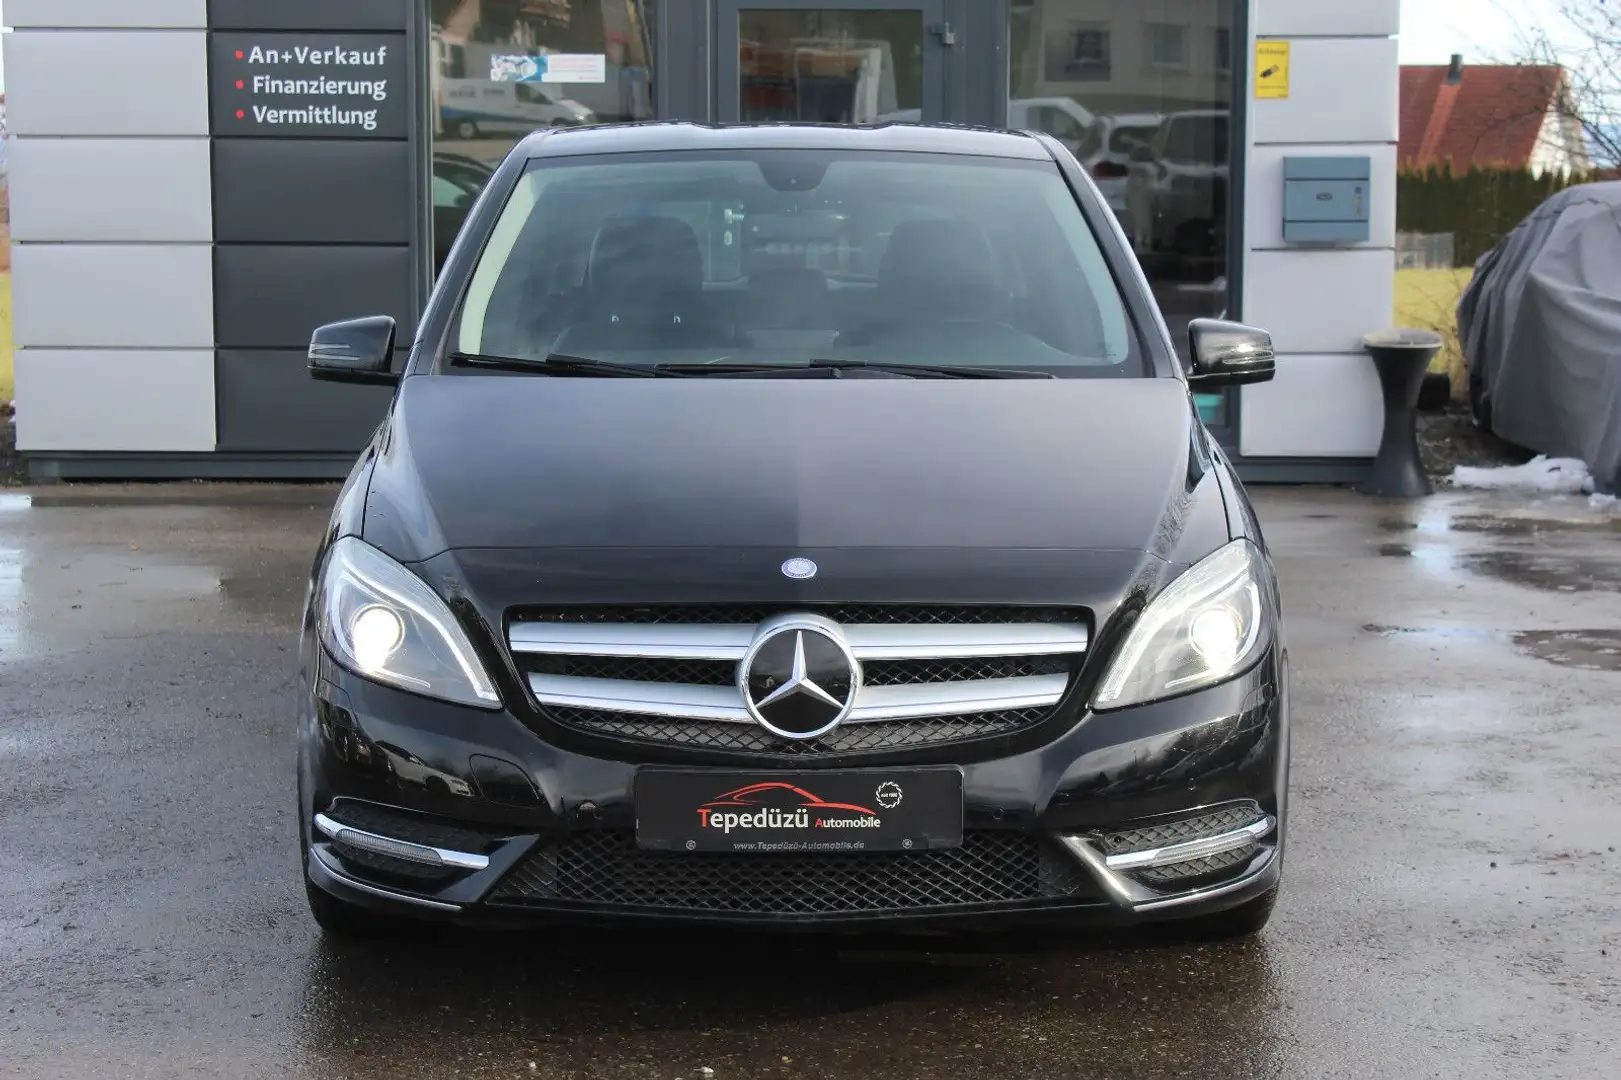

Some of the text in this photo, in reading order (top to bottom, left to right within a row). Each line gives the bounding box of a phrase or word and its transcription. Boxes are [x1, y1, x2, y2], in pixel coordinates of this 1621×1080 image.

[248, 46, 387, 65] An+Verkauf
[253, 75, 387, 101] Finanzierung
[253, 105, 377, 130] Vermittlung
[697, 808, 881, 833] Tepedüzü Automobile
